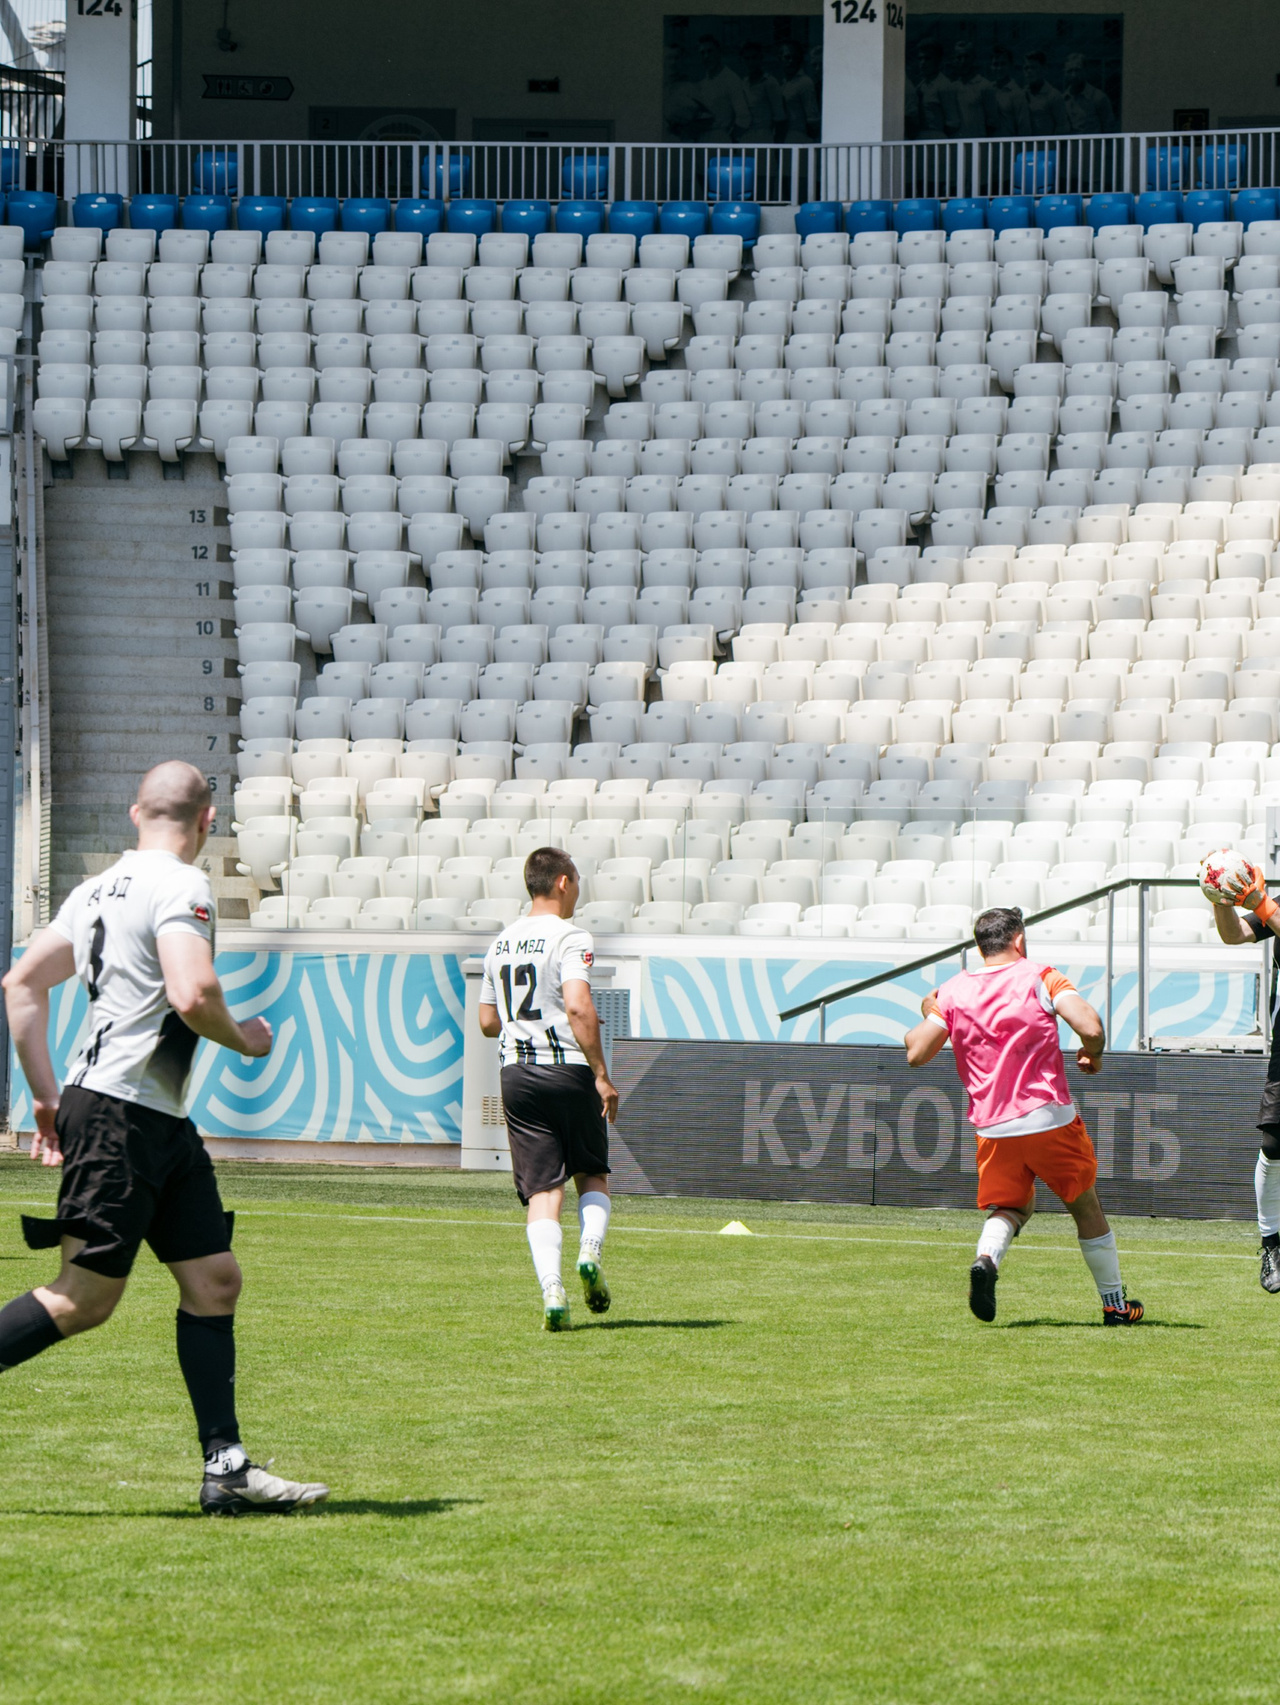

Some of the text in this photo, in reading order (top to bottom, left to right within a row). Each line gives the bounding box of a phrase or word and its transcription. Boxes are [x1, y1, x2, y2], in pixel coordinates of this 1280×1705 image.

[75, 0, 123, 16] 124
[831, 0, 877, 23] 124
[886, 2, 903, 30] 124
[189, 509, 206, 524] 13
[191, 545, 208, 560] 12
[195, 581, 210, 596] 11
[196, 620, 214, 636] 10
[202, 660, 213, 675] 9
[204, 696, 215, 711] 8
[206, 735, 218, 751] 7
[496, 939, 546, 956] ВА МВД
[499, 962, 543, 1023] 12
[741, 1079, 1182, 1182] КУБО ТБ
